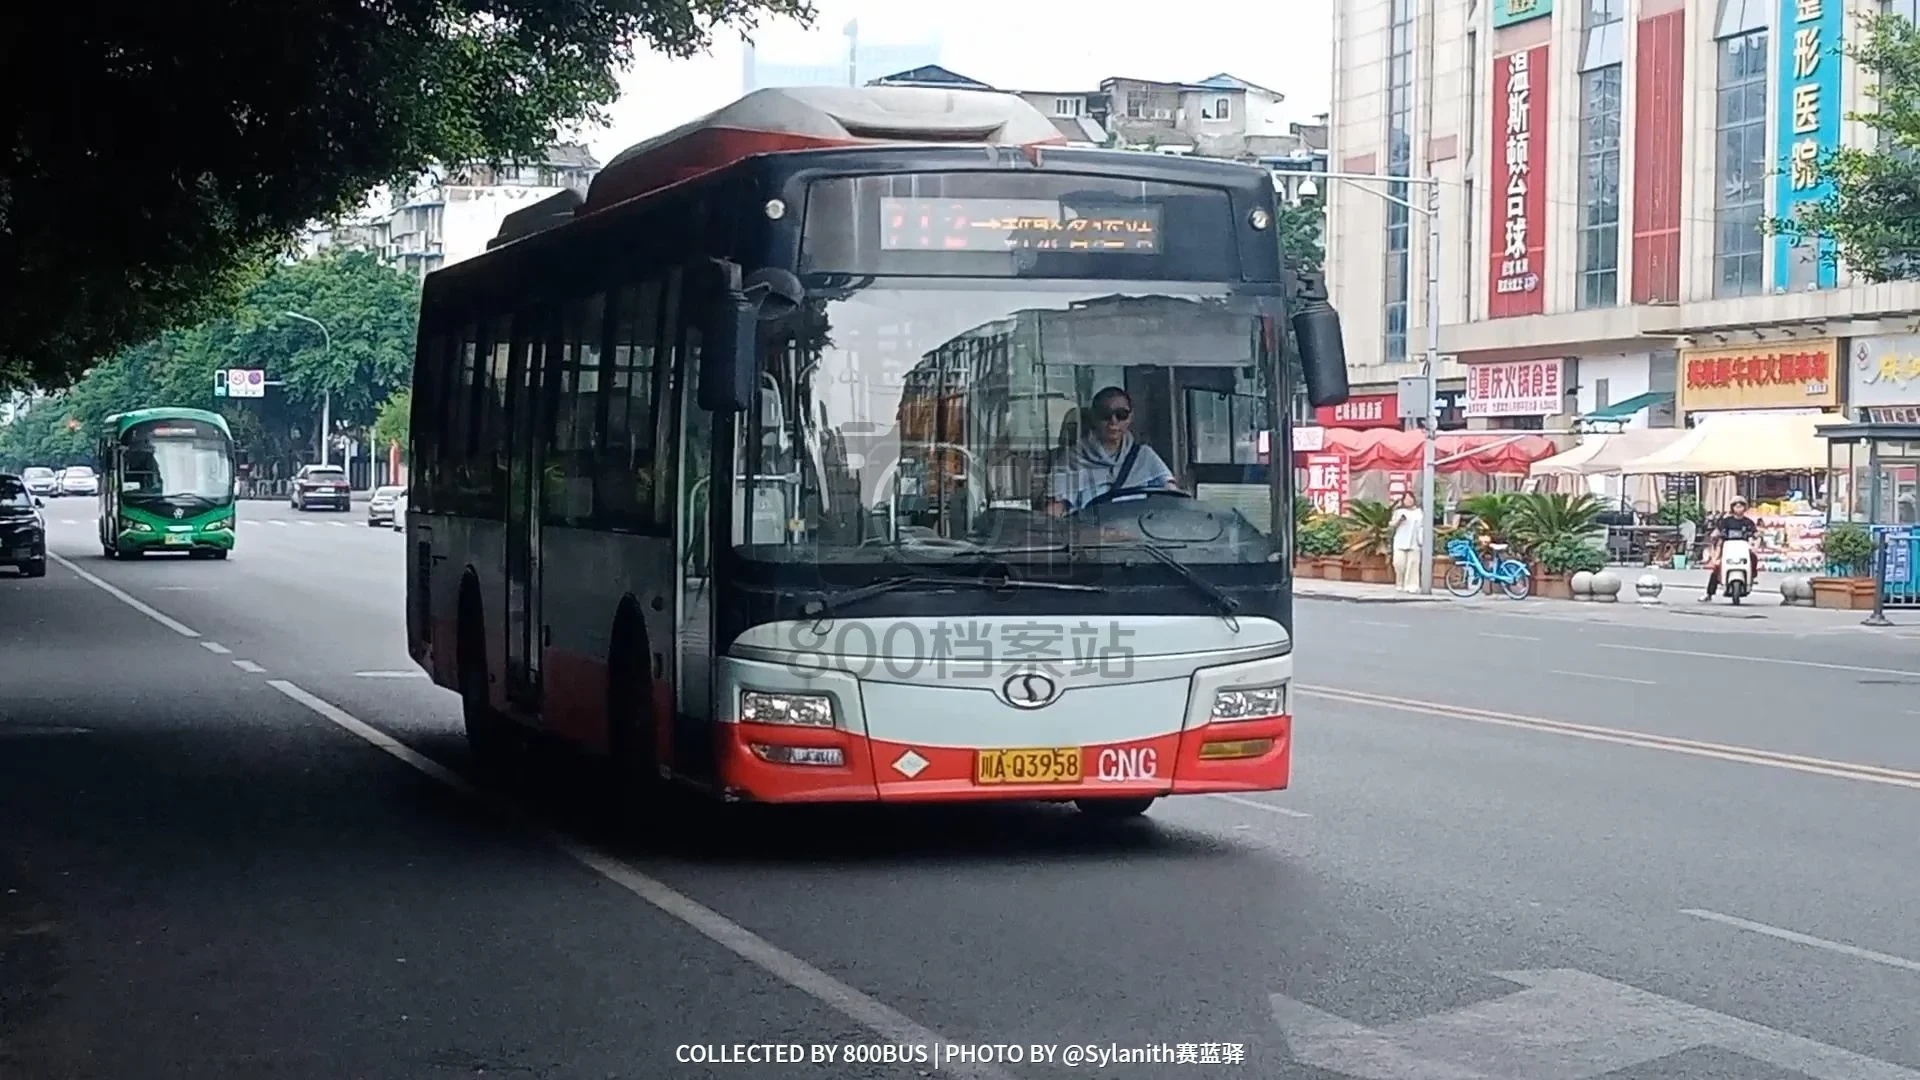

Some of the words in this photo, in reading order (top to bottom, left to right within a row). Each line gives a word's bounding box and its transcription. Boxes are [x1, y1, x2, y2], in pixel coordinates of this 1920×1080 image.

[1505, 50, 1530, 258] 温斯顿台球
[1098, 747, 1157, 781] CNG
